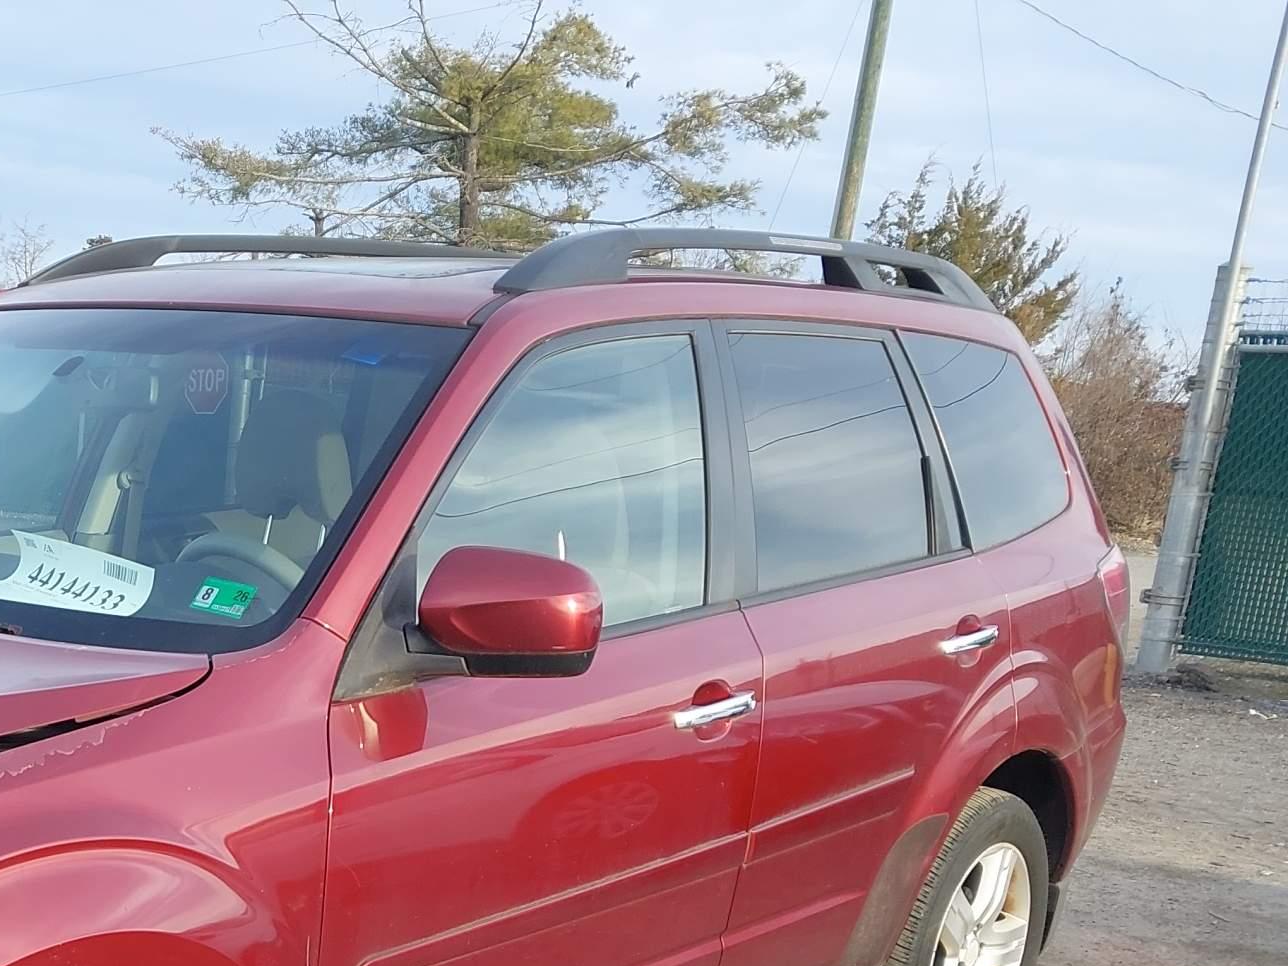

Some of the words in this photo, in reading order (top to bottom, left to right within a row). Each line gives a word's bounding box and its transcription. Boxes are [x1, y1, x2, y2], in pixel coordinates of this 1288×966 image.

[187, 368, 225, 393] STOP
[27, 562, 126, 611] 44144133
[201, 587, 214, 601] 8
[232, 590, 250, 603] 26
